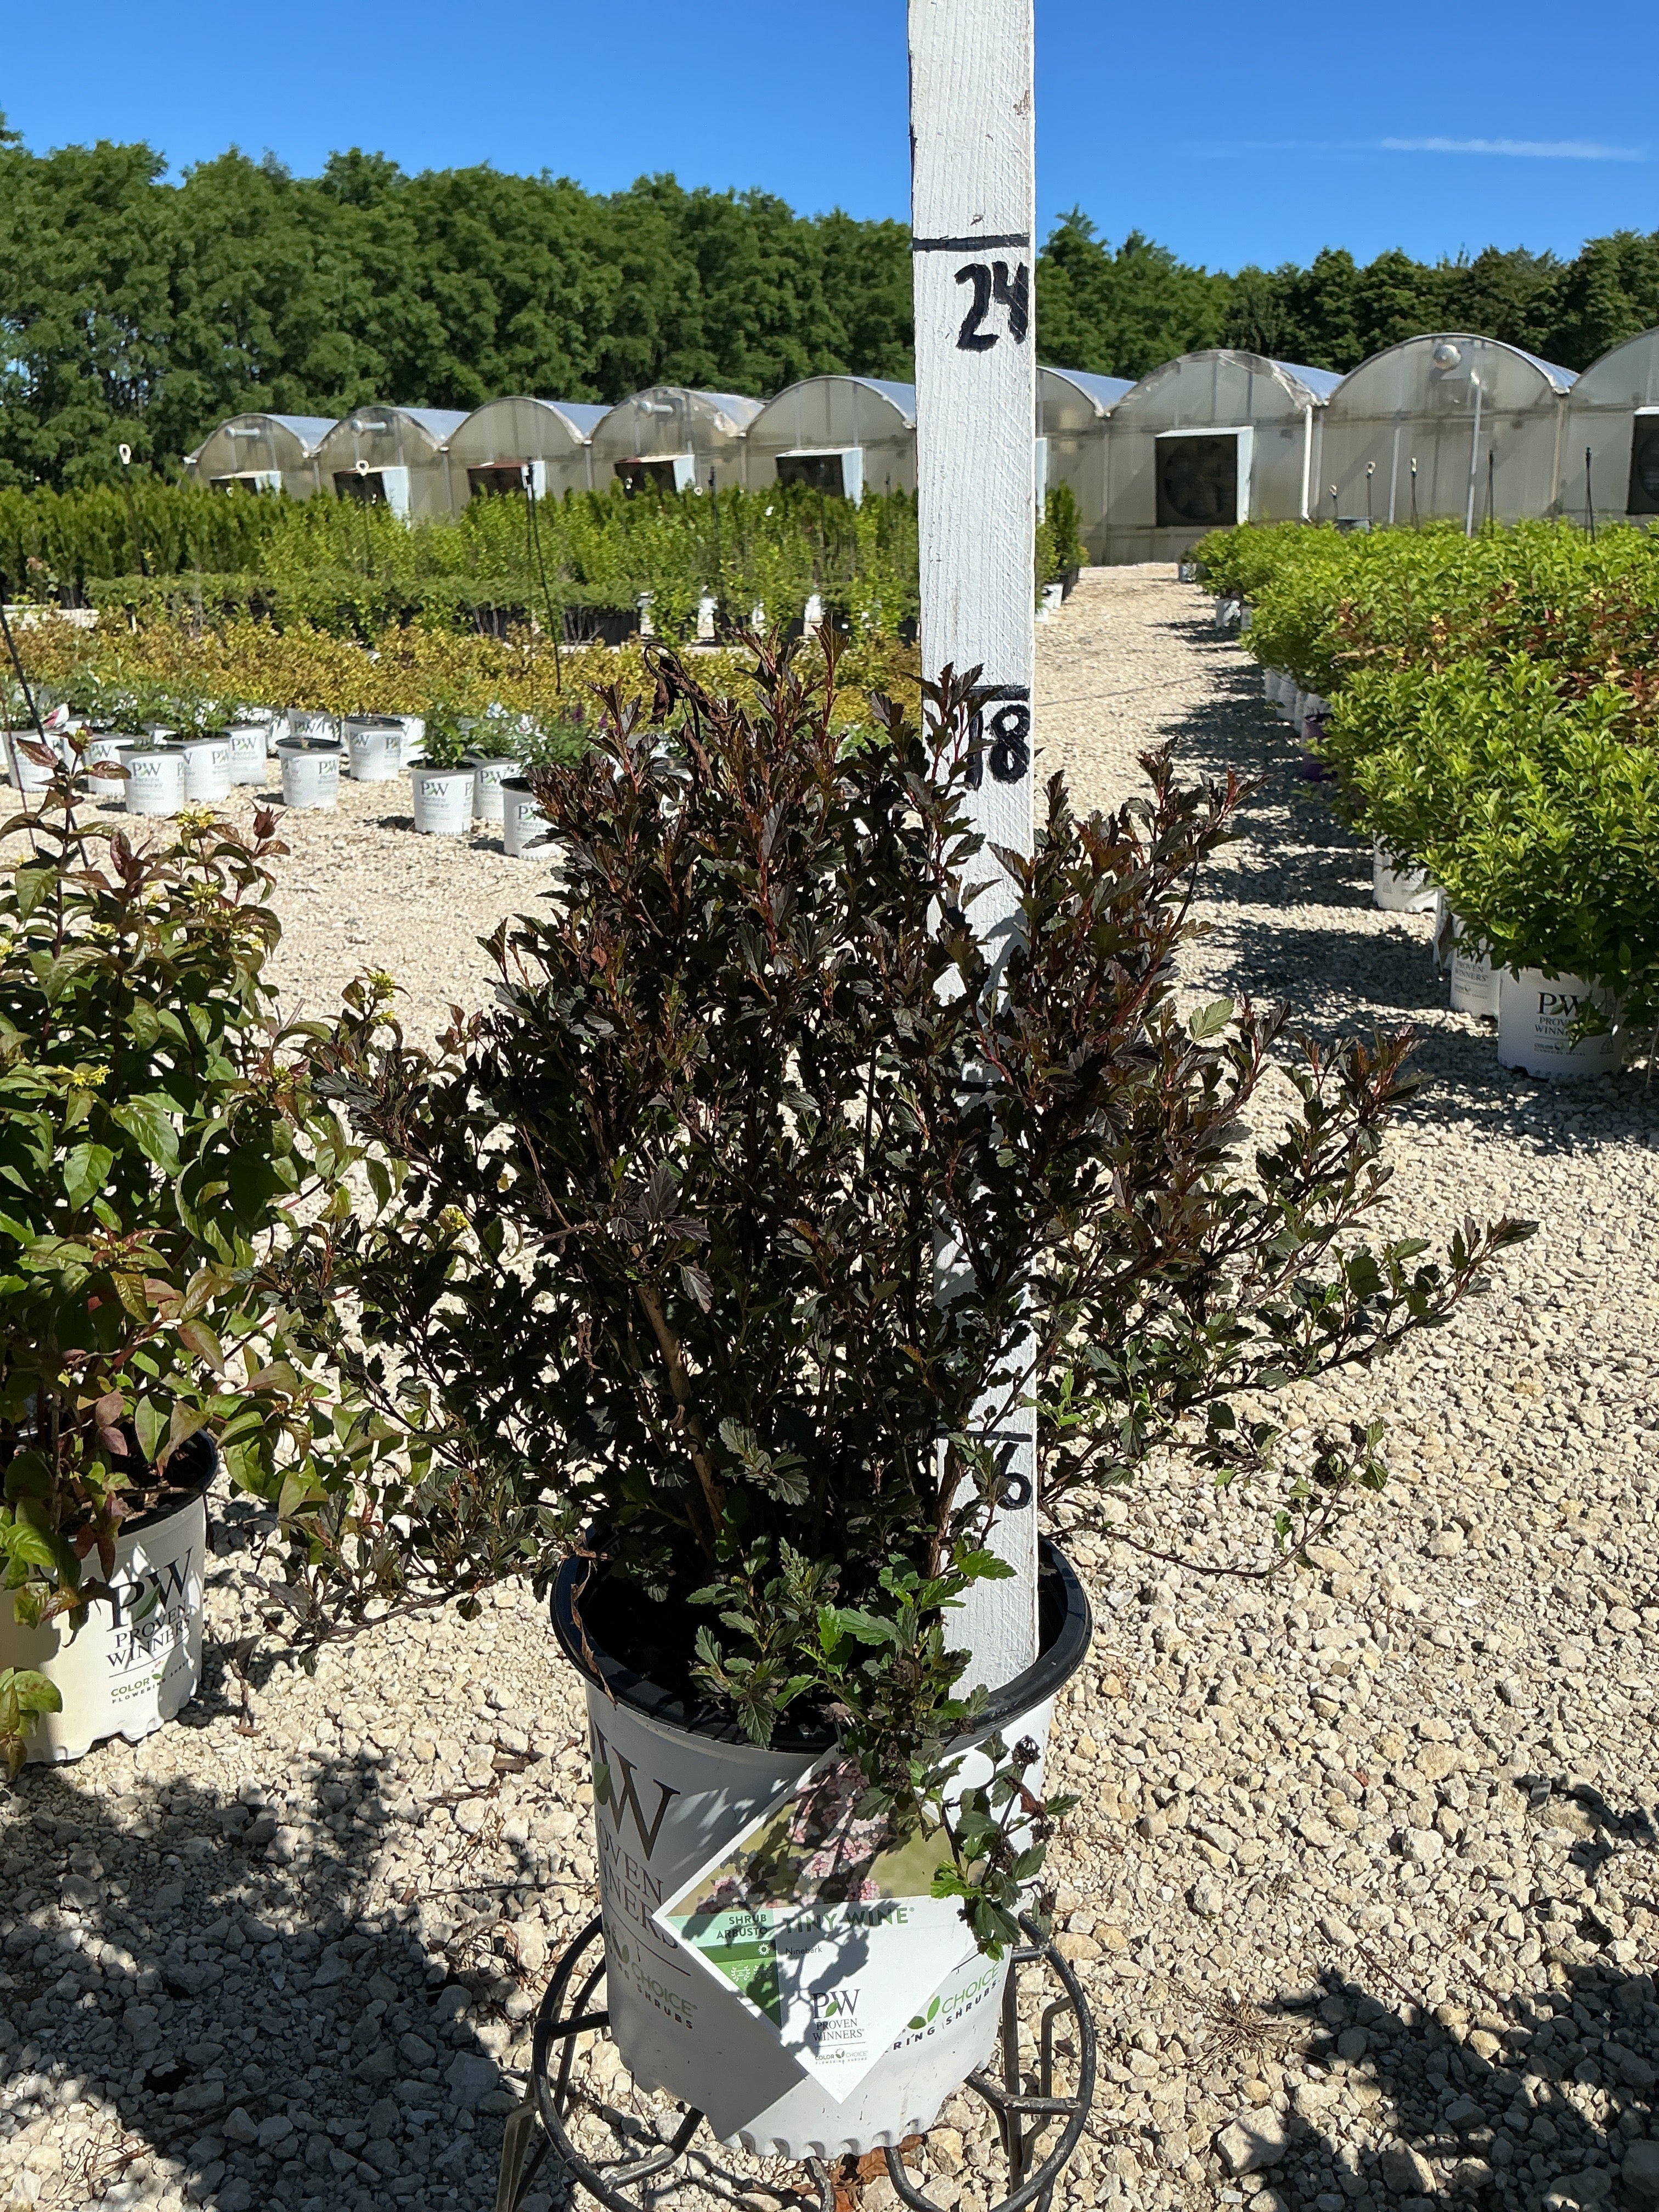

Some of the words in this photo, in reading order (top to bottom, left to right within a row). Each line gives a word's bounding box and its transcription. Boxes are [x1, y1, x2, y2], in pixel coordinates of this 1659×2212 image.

[953, 261, 1029, 353] 24
[232, 736, 257, 751] PW
[964, 704, 1031, 792] 18
[132, 761, 161, 777] PW
[420, 780, 449, 797] PW
[1539, 1016, 1568, 1026] PROV
[995, 1442, 1032, 1510] 6
[106, 1546, 194, 1633] PW
[105, 1613, 190, 1667] WINNERS
[114, 1600, 188, 1649] PROVEN
[111, 1677, 150, 1697] COLOR
[590, 1719, 681, 1862] W
[599, 1817, 664, 1906] OVEN
[716, 1926, 768, 1940] ARBUSTO
[729, 1914, 767, 1925] SHRUB
[782, 1913, 838, 1934] TINY
[785, 1944, 823, 1956] Ninebark
[636, 1983, 693, 2029] SHRUBS
[811, 1989, 861, 2019] PW
[941, 1961, 1000, 2014] CHOICE
[945, 1979, 997, 2025] SHRUBS
[816, 2018, 857, 2030] PROVEN
